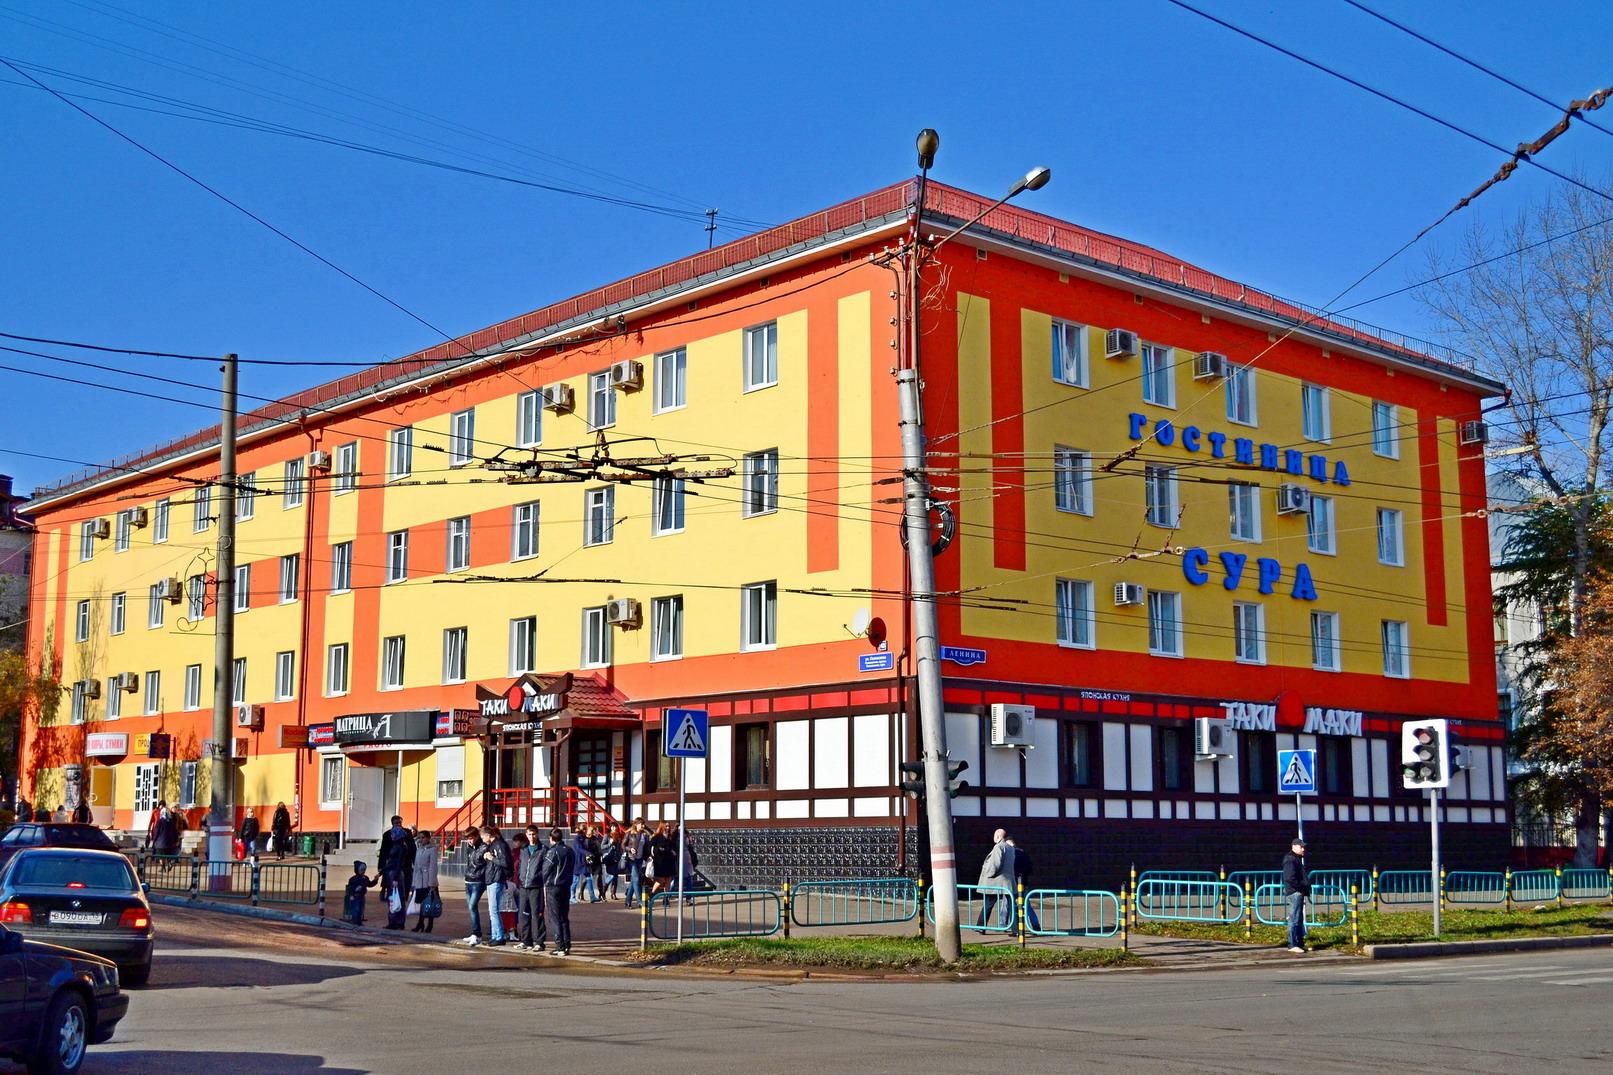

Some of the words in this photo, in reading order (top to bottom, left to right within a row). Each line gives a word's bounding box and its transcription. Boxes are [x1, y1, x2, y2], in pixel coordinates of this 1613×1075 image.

[1128, 412, 1352, 486] ГОСТИНИЦА
[1183, 547, 1318, 601] СУРА
[949, 650, 981, 659] ЛЕНИНА
[479, 698, 508, 716] ТАКИ
[521, 693, 556, 713] МАКИ
[336, 715, 373, 733] МАТРИЦА
[1219, 702, 1277, 732] ТАКИ
[1303, 707, 1363, 737] МАКИ
